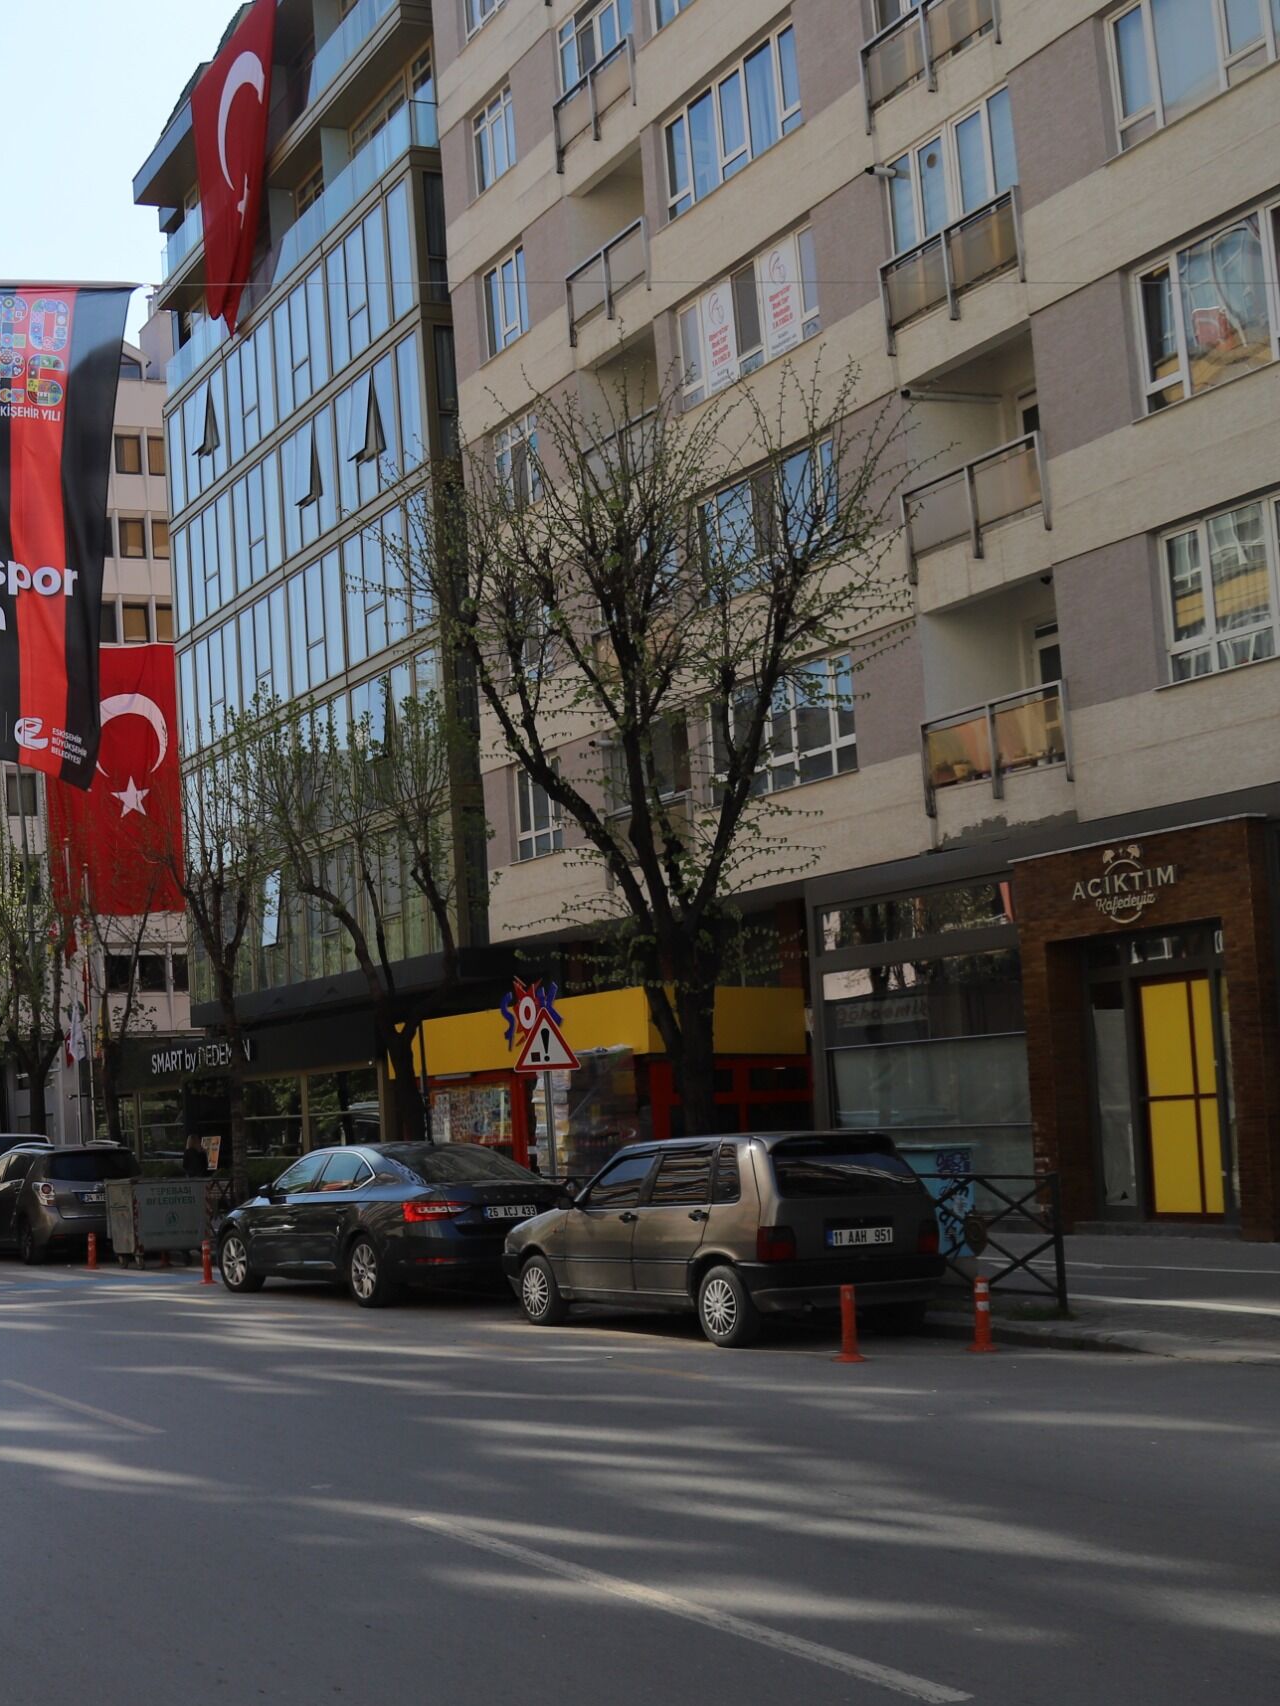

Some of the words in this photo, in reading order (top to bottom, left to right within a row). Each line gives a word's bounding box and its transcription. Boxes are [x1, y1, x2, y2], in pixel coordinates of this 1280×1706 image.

[41, 409, 61, 422] YILI
[51, 727, 83, 745] ESKİŞEHİR
[51, 737, 88, 759] BÜYÜKŞEHİR
[51, 746, 81, 766] BELEDİYESİ
[1072, 864, 1176, 901] ACIKTIM
[1095, 890, 1156, 916] Kafedeyiz
[151, 1049, 183, 1075] SMART
[184, 1047, 197, 1073] by
[487, 1207, 499, 1218] 26
[503, 1206, 518, 1217] ACJ
[521, 1205, 536, 1217] 433
[834, 1231, 843, 1245] 11
[848, 1230, 867, 1244] AAH
[874, 1228, 891, 1242] 951
